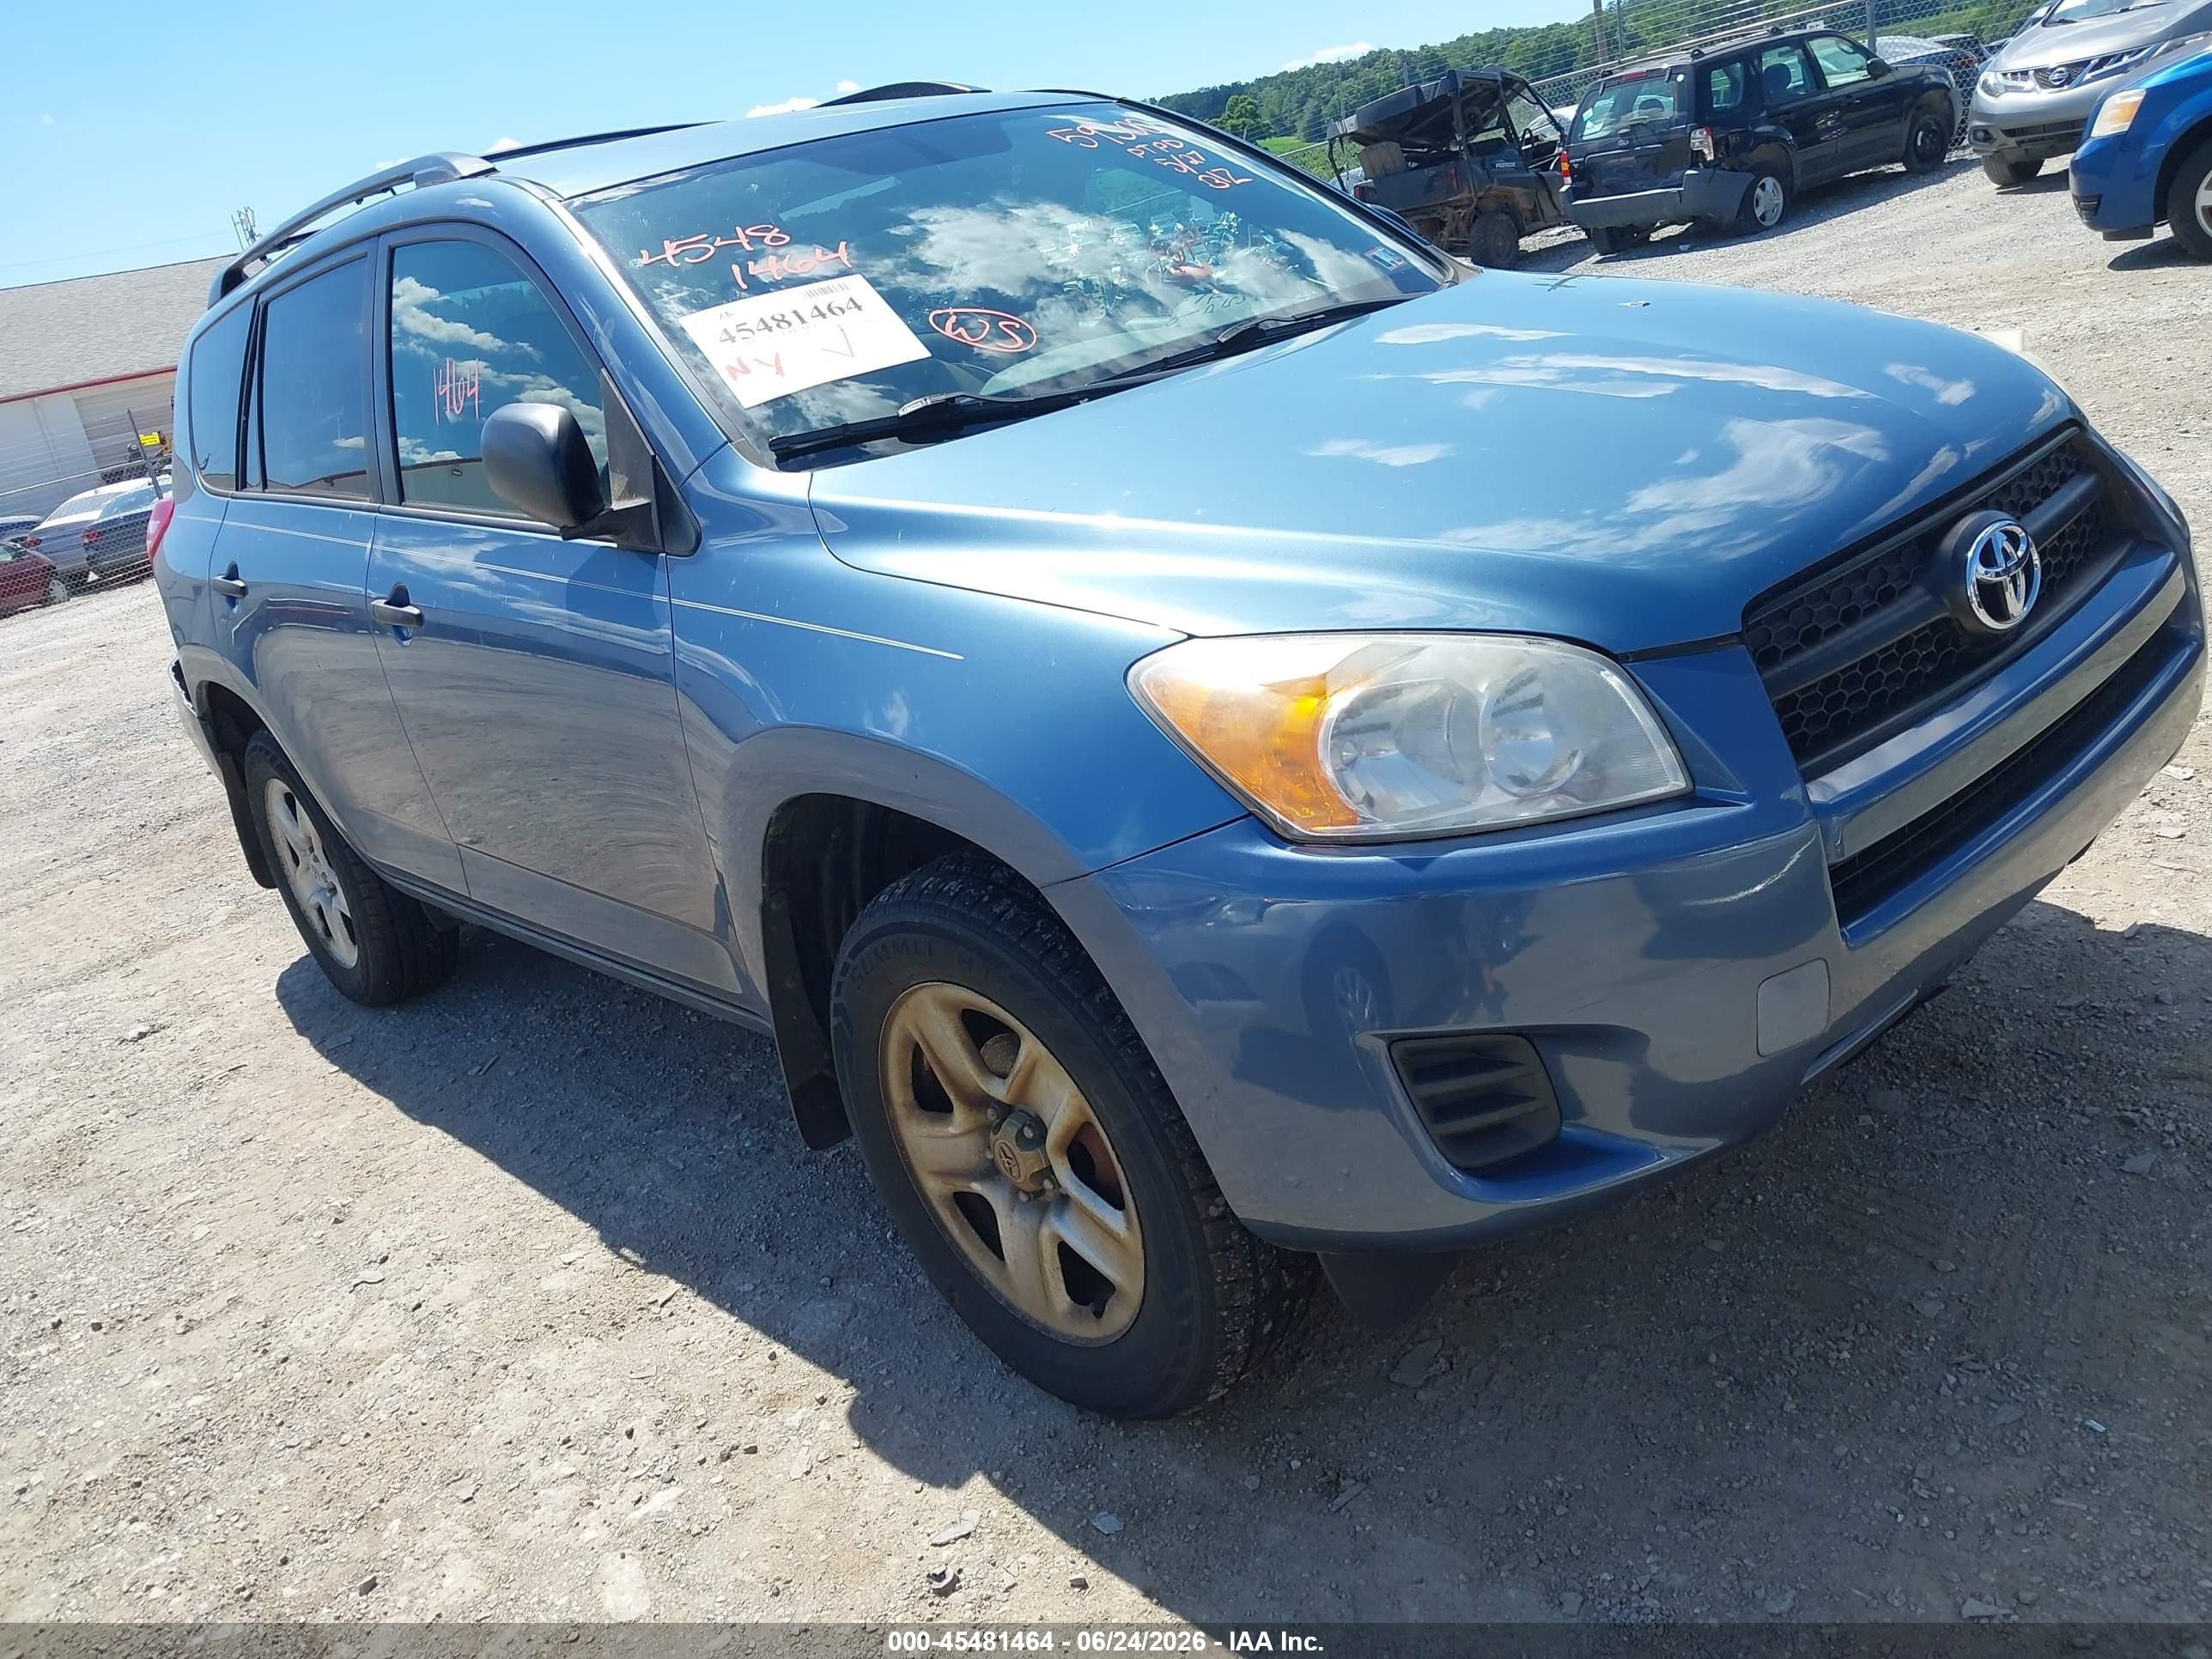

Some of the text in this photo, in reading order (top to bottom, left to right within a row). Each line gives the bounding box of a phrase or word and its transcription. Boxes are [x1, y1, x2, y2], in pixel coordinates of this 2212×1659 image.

[640, 224, 791, 267] 4548
[732, 240, 853, 289] 1464
[720, 296, 863, 343] 45481464
